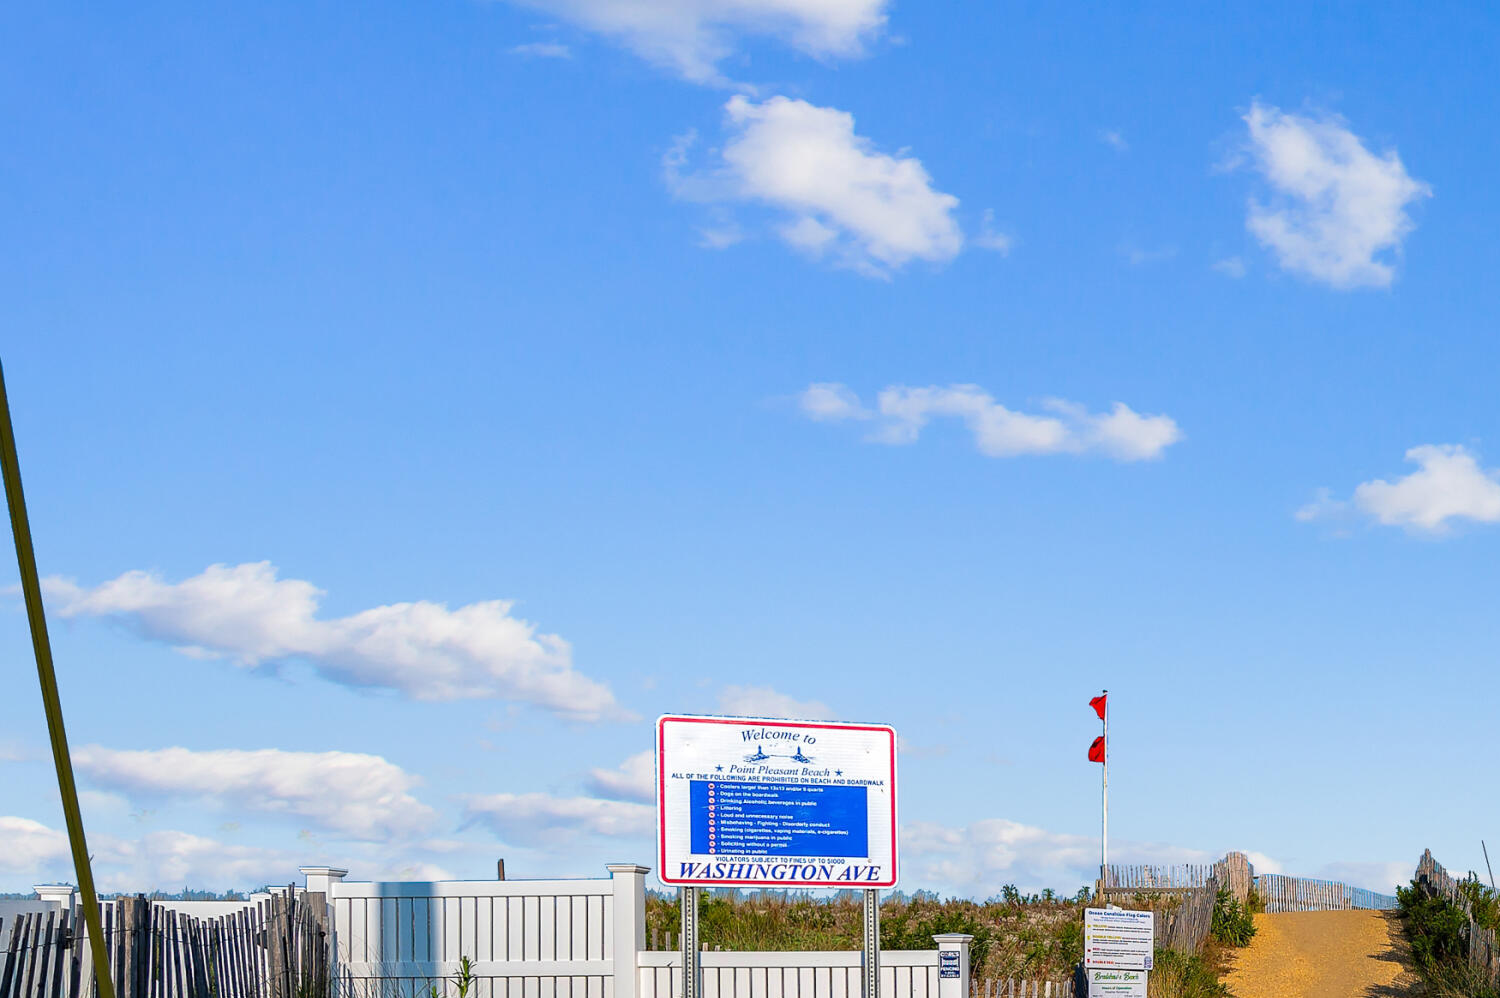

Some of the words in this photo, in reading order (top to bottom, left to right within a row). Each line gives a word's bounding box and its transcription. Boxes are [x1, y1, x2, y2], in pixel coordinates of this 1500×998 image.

[741, 728, 800, 743] Welcome
[803, 734, 816, 745] to
[729, 764, 755, 774] Point
[758, 766, 799, 776] Pleasant
[801, 767, 830, 777] Beach
[710, 774, 746, 782] FOLLOWING
[763, 776, 799, 784] PROHIBITED
[751, 856, 778, 864] SUBJECT
[679, 862, 835, 881] WASHINGTON
[836, 865, 881, 881] AVE
